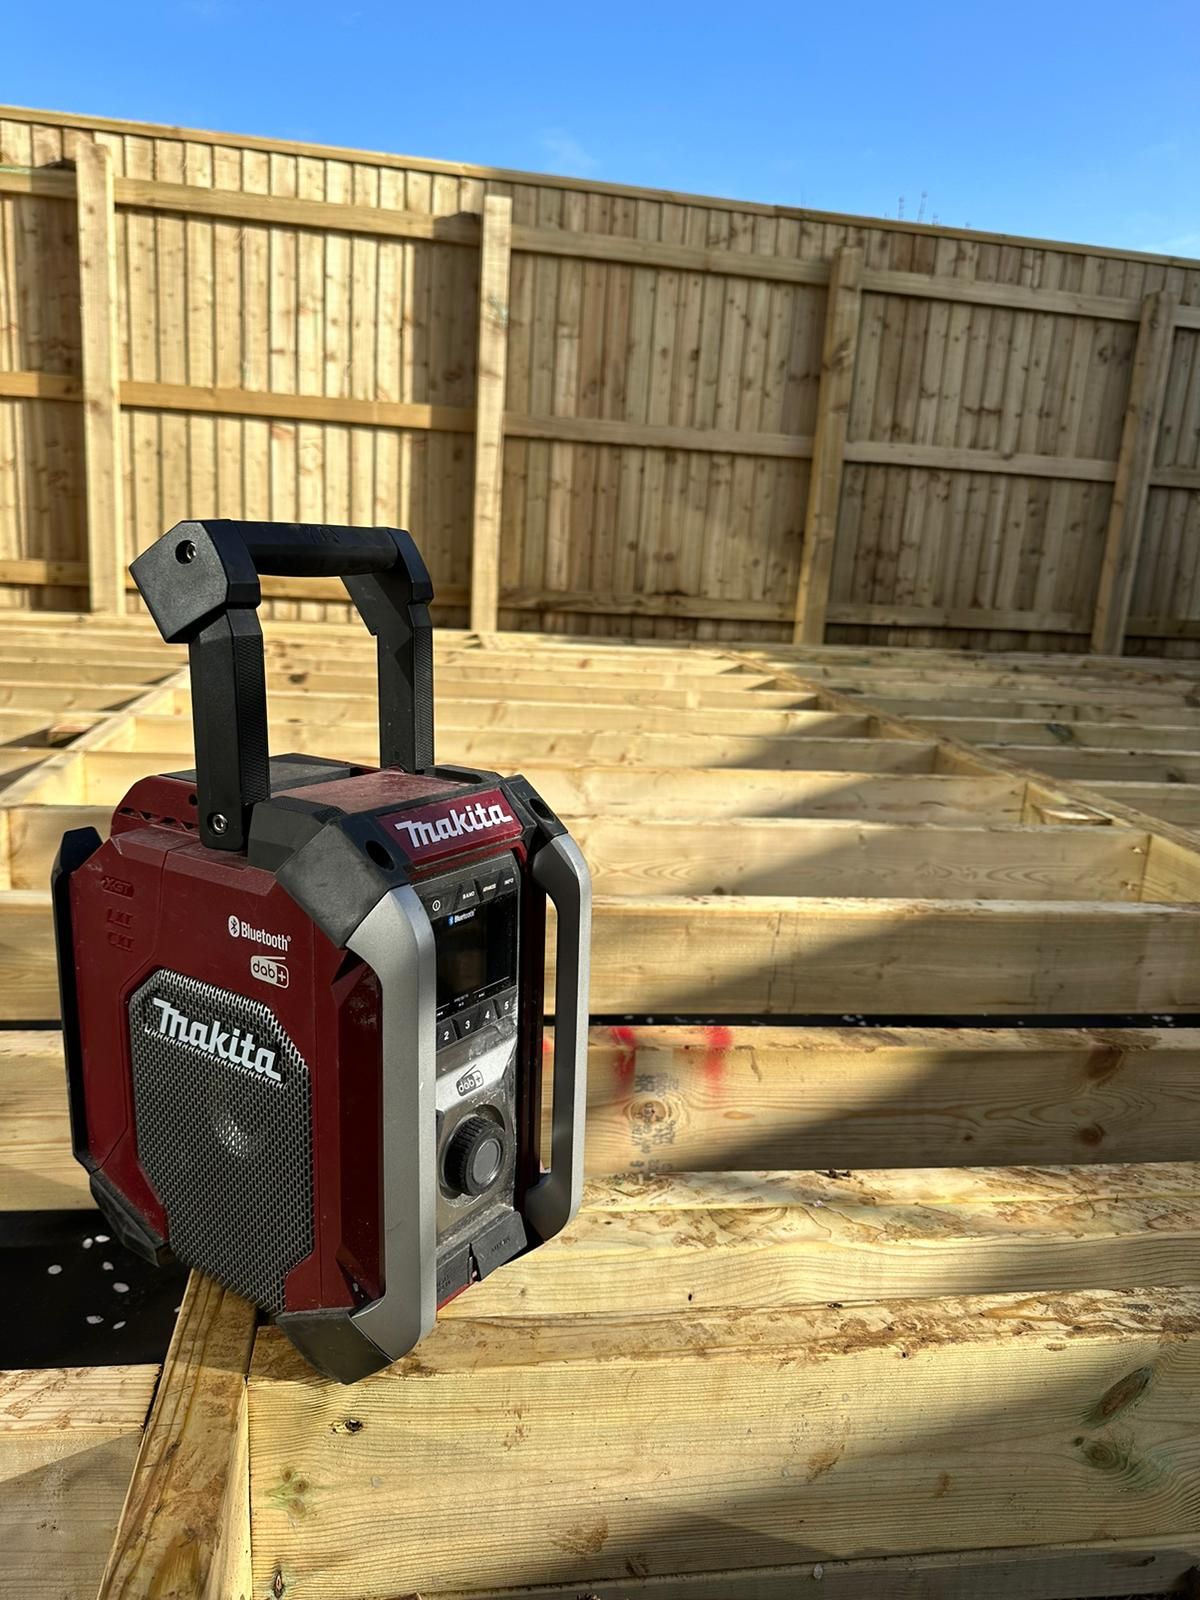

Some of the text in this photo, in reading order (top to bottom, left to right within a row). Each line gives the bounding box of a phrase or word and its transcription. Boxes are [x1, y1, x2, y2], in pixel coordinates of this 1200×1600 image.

[395, 802, 513, 848] Makita
[153, 997, 281, 1081] Makita
[444, 1001, 510, 1040] 2 3 4 5
